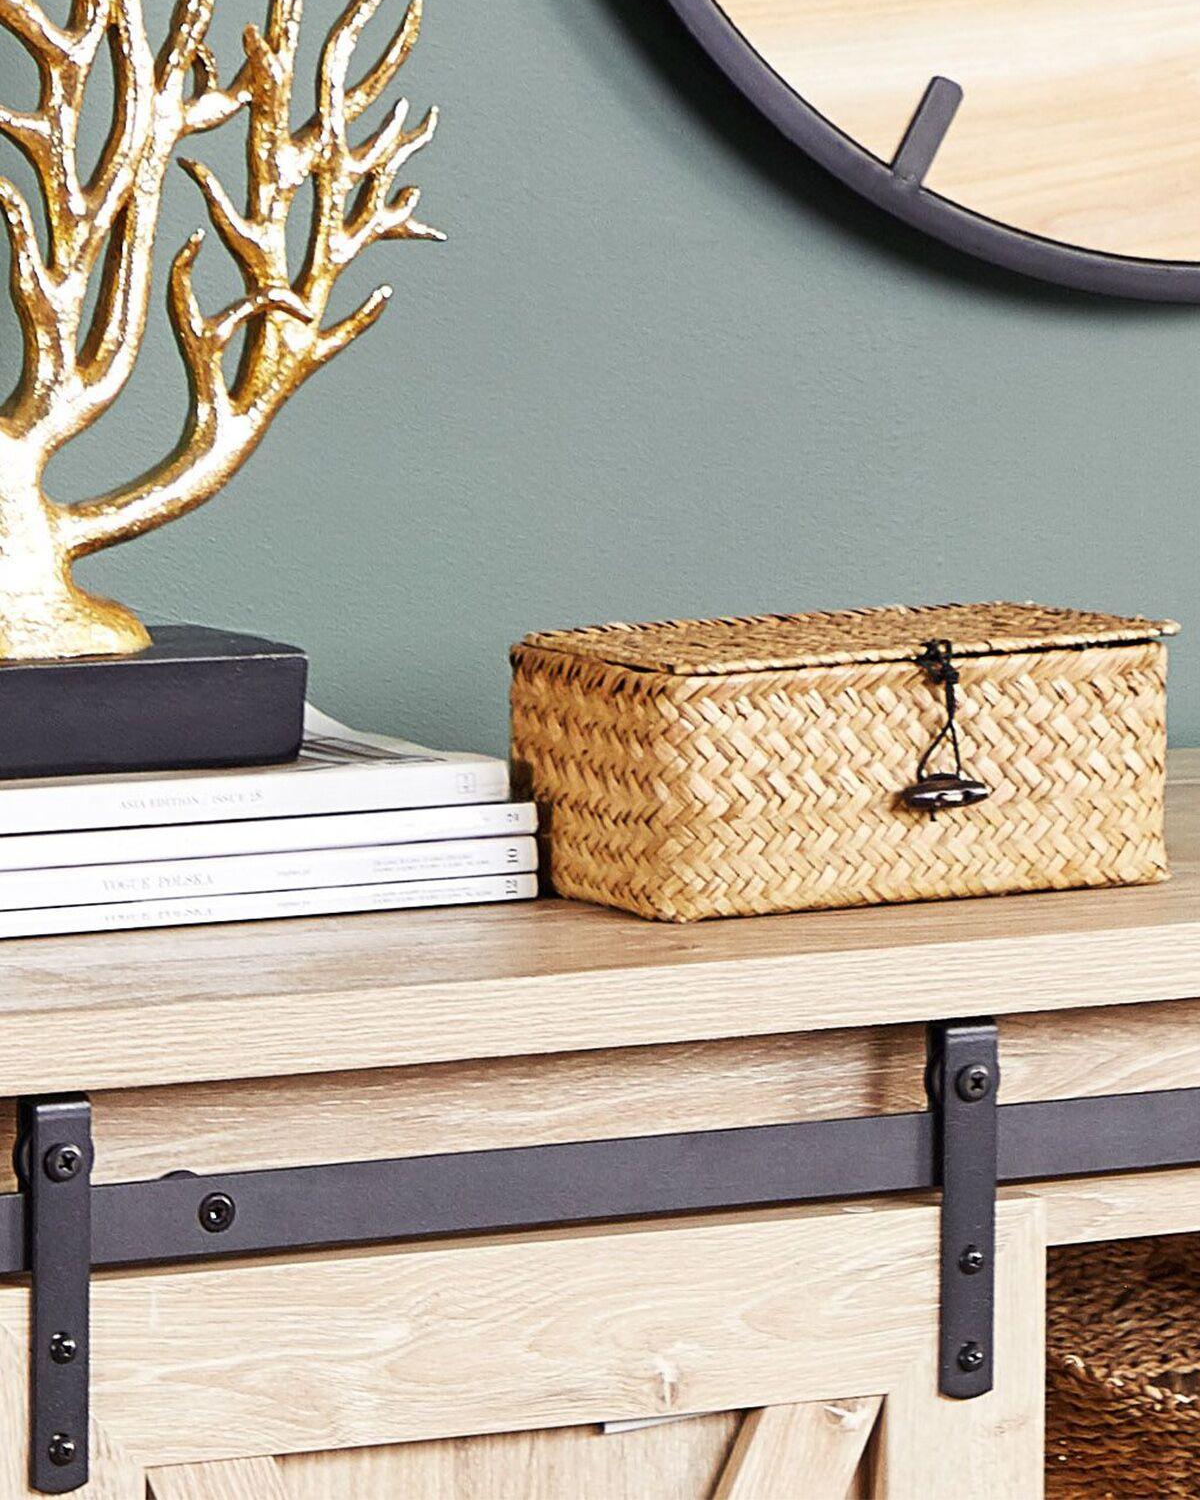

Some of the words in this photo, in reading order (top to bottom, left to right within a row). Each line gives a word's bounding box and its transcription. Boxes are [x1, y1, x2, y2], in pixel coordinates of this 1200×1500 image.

[119, 799, 146, 810] ASIA
[149, 795, 199, 808] EDITION
[211, 791, 244, 804] ISSUE
[506, 847, 519, 864] 10
[101, 876, 150, 891] VOGUE
[158, 873, 214, 888] POLSKA
[505, 879, 518, 894] 12
